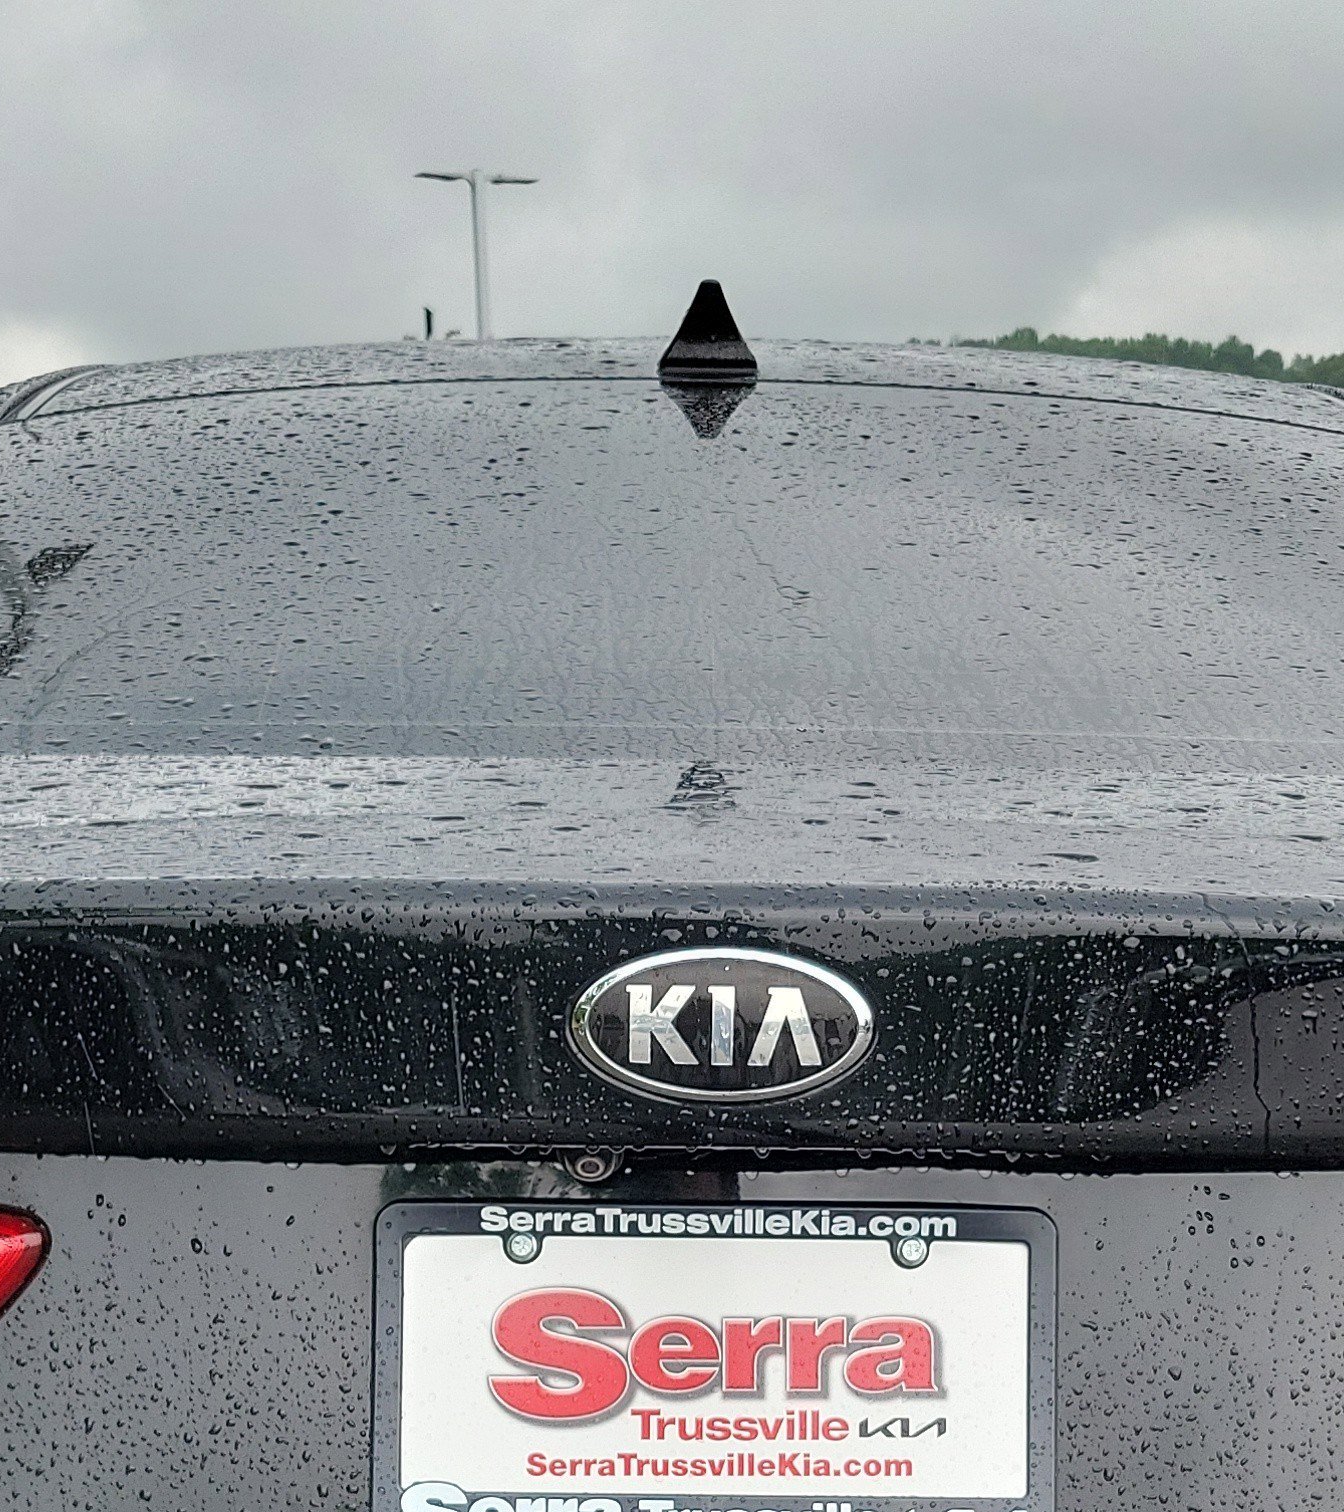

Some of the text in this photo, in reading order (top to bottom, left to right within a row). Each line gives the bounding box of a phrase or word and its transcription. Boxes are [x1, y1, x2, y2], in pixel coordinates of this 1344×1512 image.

[626, 984, 823, 1067] KIA
[480, 1205, 957, 1237] SerraTrussvilleKia.com
[488, 1286, 940, 1420] Serra
[630, 1408, 850, 1442] Trussville
[525, 1451, 914, 1478] SerraTrussvilleKia.com
